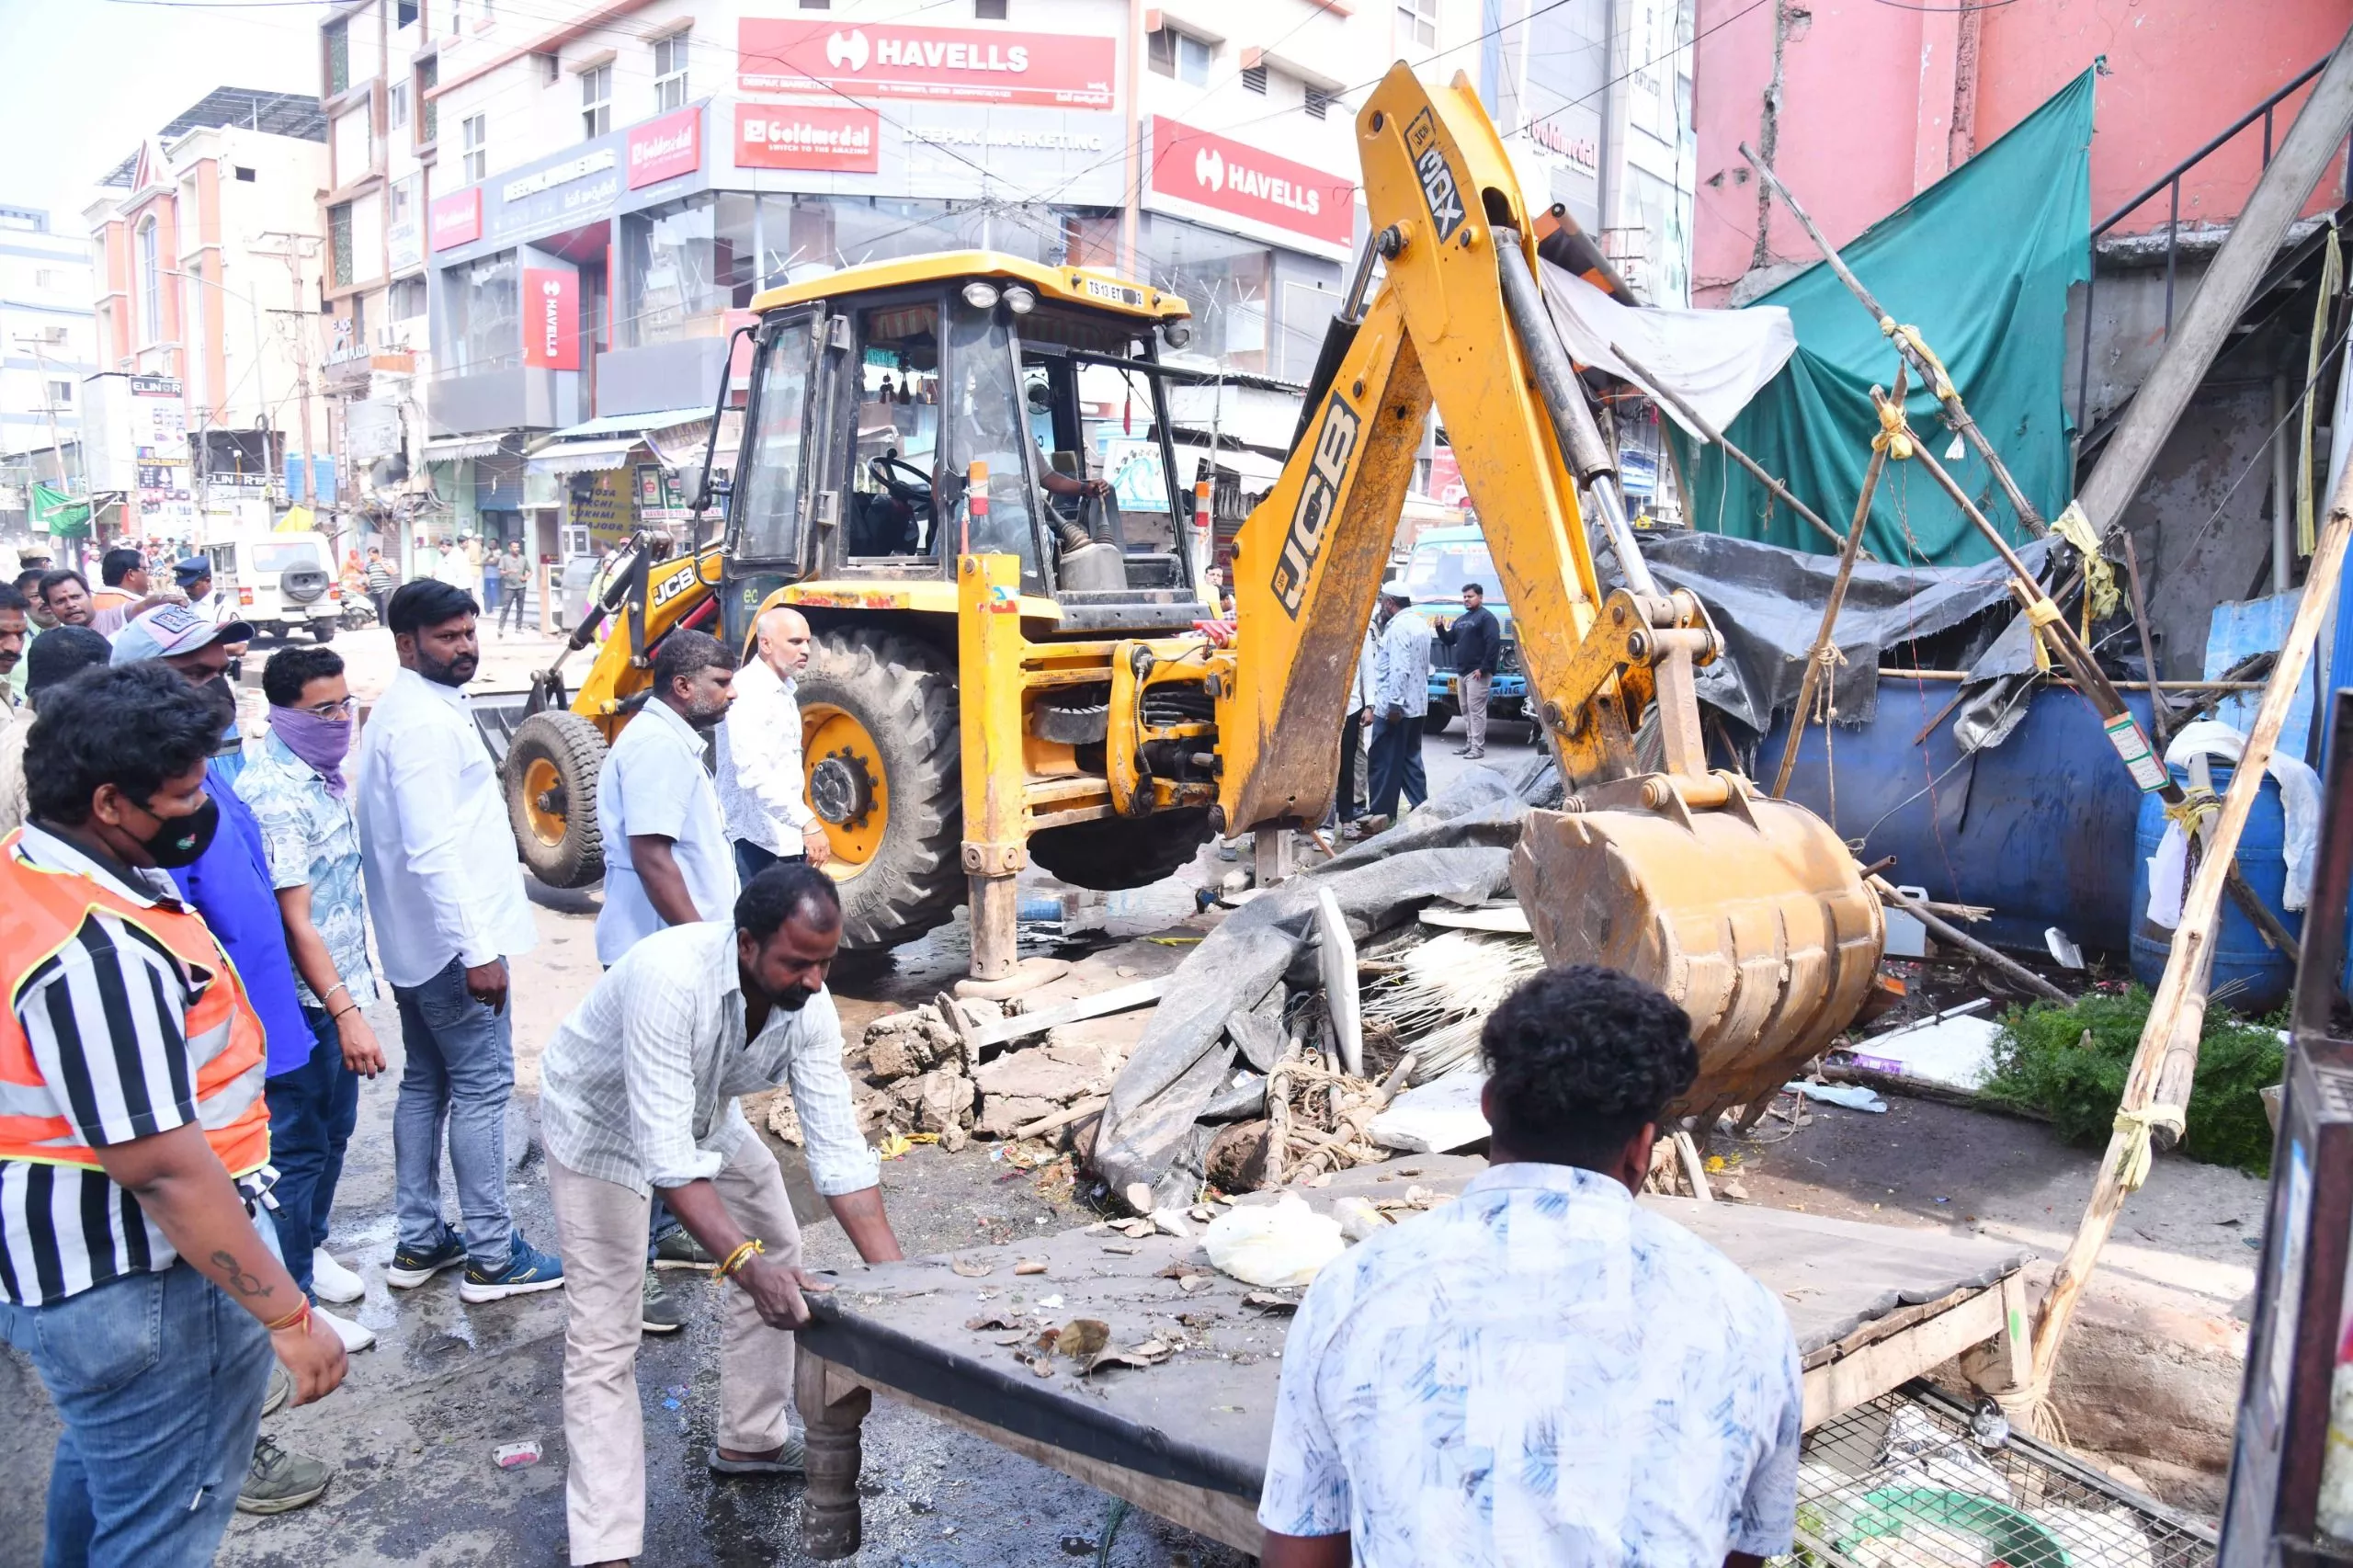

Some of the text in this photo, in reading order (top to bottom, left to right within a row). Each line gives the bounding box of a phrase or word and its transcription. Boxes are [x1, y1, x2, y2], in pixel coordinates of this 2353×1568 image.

[877, 39, 1029, 73] HAVELLS
[768, 120, 870, 146] Goldmedal
[902, 127, 1102, 152] DEEPAK MARKETING
[1414, 125, 1430, 145] JCB
[1228, 163, 1320, 216] HAVELLS
[1418, 147, 1465, 222] 3DX
[1089, 281, 1099, 295] TS
[1101, 285, 1109, 297] 13
[1111, 288, 1121, 301] ET
[546, 299, 558, 358] HAVELLS
[1285, 404, 1356, 609] JCB
[654, 566, 696, 607] JCB
